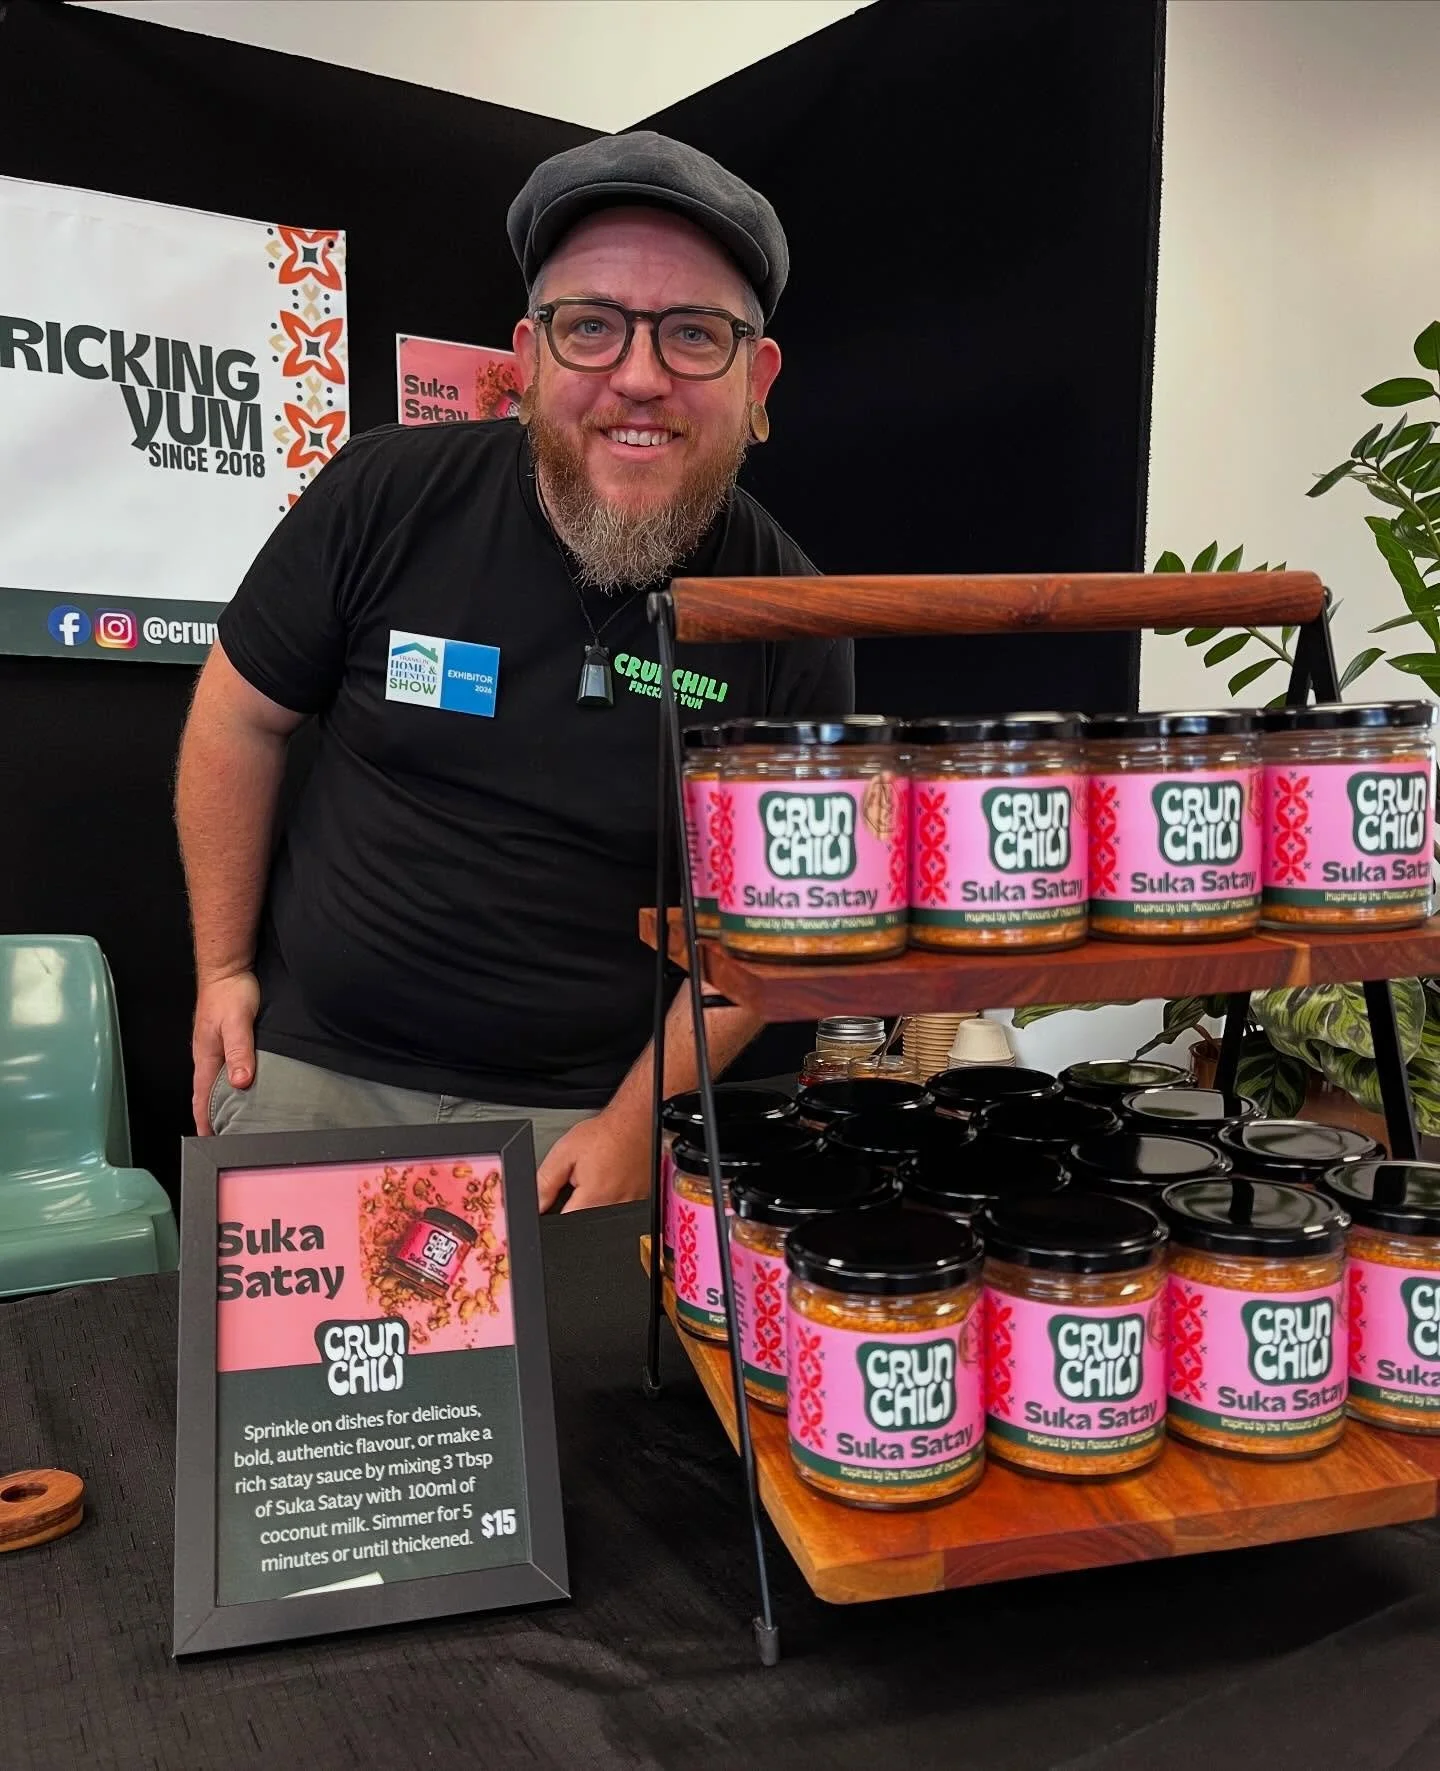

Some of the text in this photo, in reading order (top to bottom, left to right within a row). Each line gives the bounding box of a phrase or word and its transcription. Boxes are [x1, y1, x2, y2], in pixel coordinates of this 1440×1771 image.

[404, 374, 459, 401] Suka
[120, 384, 263, 452] YUM
[149, 442, 265, 478] SINCE 2018
[390, 670, 436, 683] LIFESTYLE
[390, 678, 436, 695] SHOW
[391, 660, 437, 675] HOME &
[448, 669, 493, 684] EXHIBITOR
[680, 693, 703, 710] YUM
[991, 791, 1069, 832] CRUN
[1161, 785, 1240, 825] CRUN
[1357, 777, 1426, 815] CRUN
[766, 797, 852, 839] CRUN
[1358, 809, 1425, 851] CHILI
[769, 831, 851, 875] CHILI
[994, 824, 1068, 869] CHILI
[1164, 818, 1239, 861] CHILI
[962, 878, 1082, 902] Suka Satay
[1131, 871, 1195, 894] Suka
[1323, 861, 1386, 882] Suka
[743, 885, 878, 910] Suka Satay
[218, 1218, 324, 1257] Suka
[218, 1264, 344, 1301] Satay
[324, 1322, 406, 1361] CRUN
[1058, 1319, 1140, 1361] CRUN
[1251, 1302, 1331, 1345] CRUN
[327, 1353, 404, 1396] CHILI
[866, 1343, 952, 1389] CRUN
[1060, 1353, 1138, 1397] CHILI
[1254, 1336, 1329, 1380] CHILI
[870, 1380, 951, 1427] CHILI
[1024, 1400, 1157, 1430] Suka Satay
[1217, 1385, 1286, 1412] Suka
[244, 1404, 482, 1443] Sprinkle on dishes for delicious,
[837, 1424, 973, 1460] Suka Satay
[234, 1426, 493, 1467] bold, authentic flavour, or make a
[235, 1451, 493, 1494] rich satay sauce by mixing 3 Tbsp
[255, 1476, 477, 1518] of Suka Satay with 100ml of
[260, 1503, 473, 1544] coconut milk. Simmer for 5
[480, 1508, 517, 1539] $15
[261, 1528, 474, 1572] minutes or until thickened.
